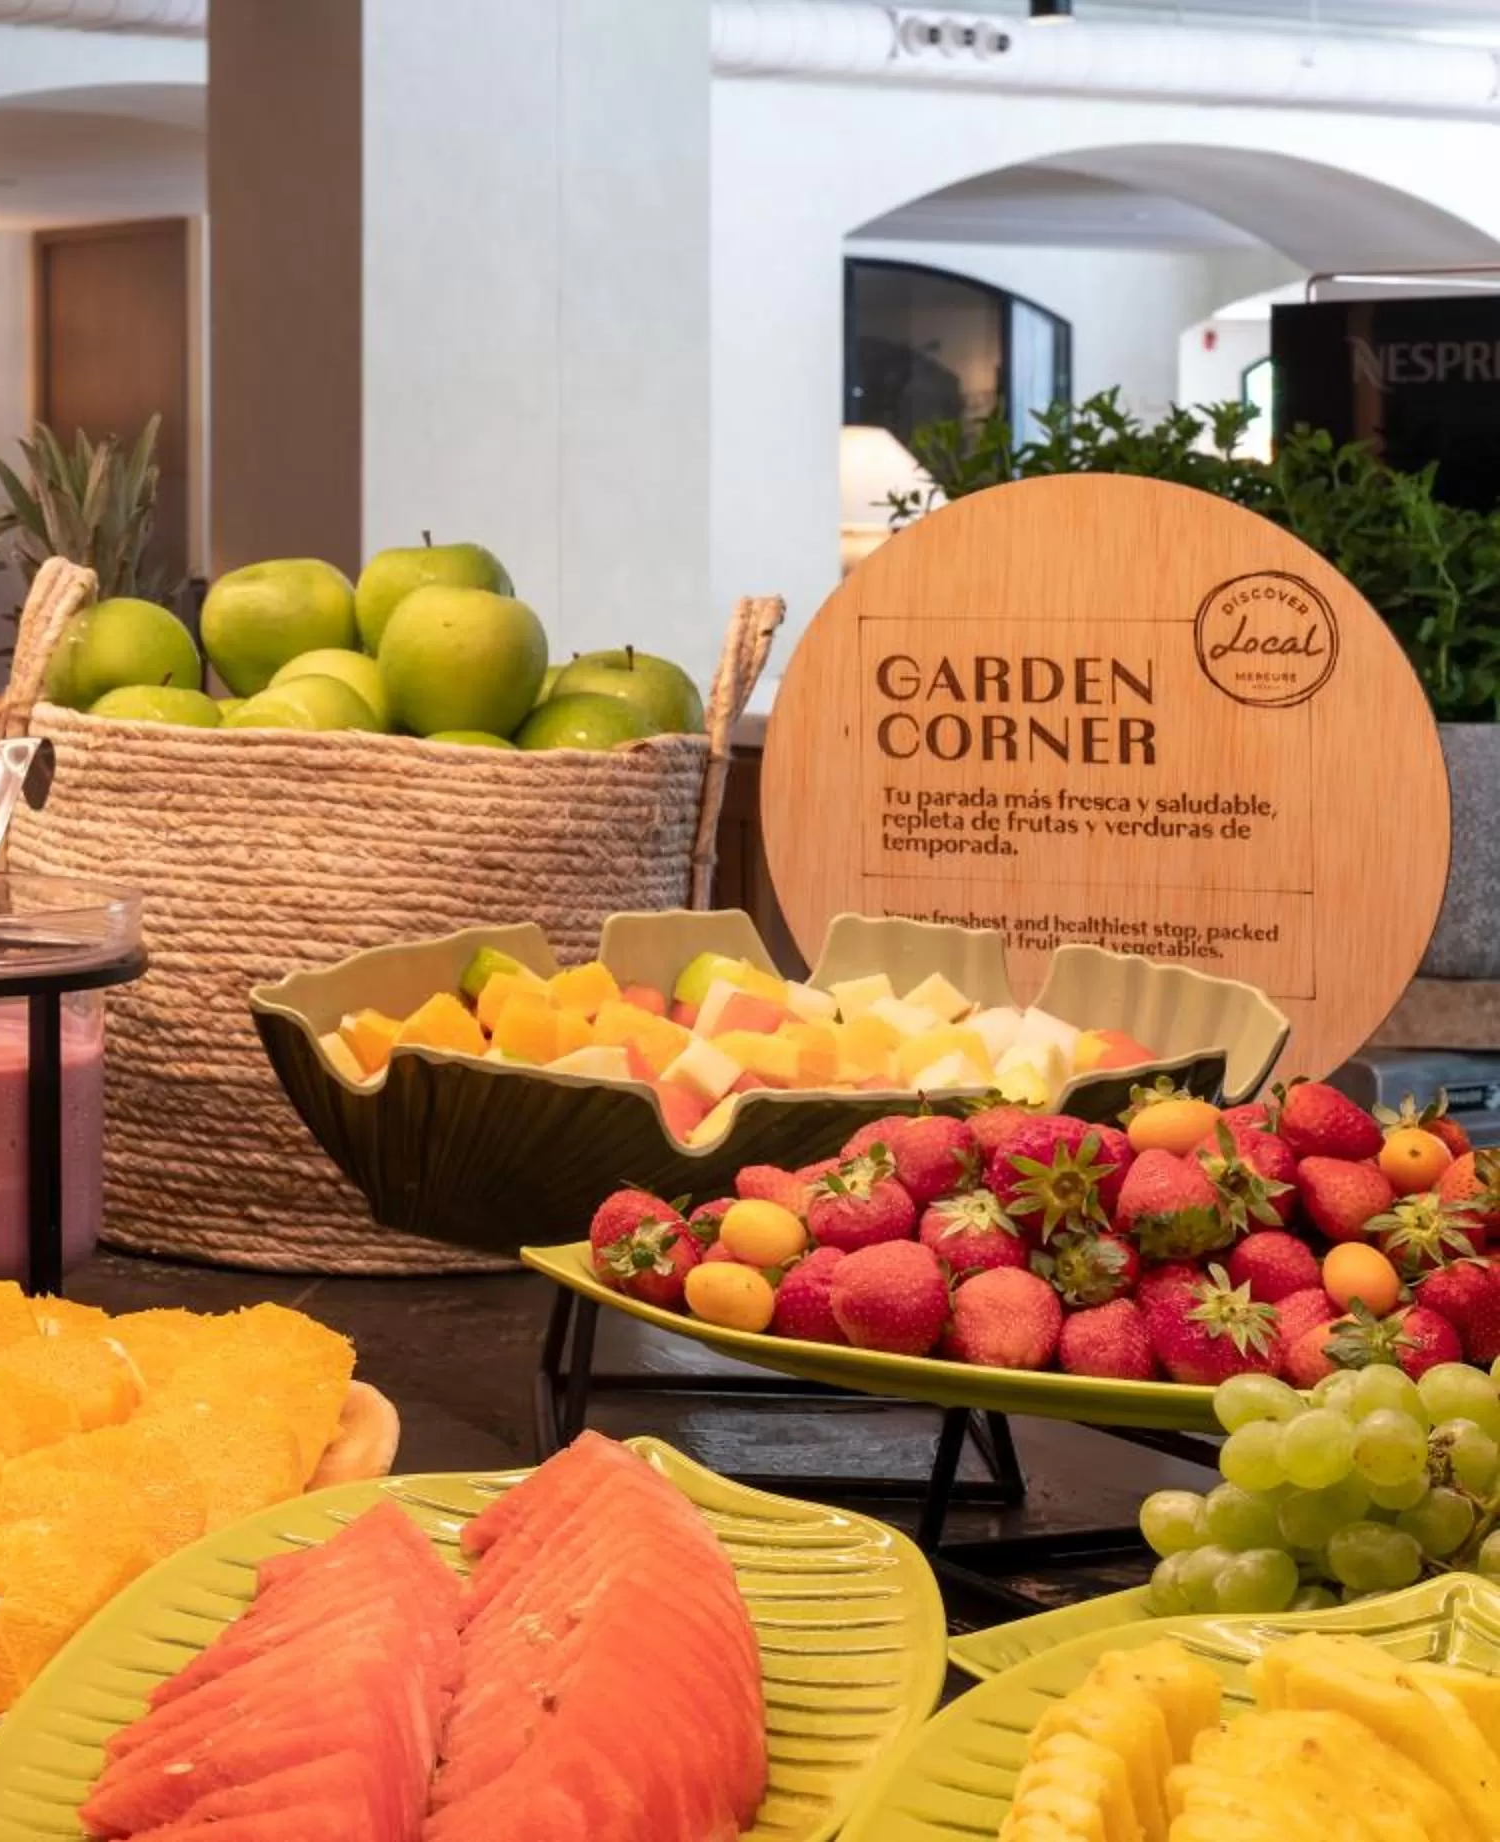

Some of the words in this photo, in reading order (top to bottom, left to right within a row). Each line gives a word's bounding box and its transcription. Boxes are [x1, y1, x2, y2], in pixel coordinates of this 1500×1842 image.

[1221, 587, 1309, 615] DISCOVER
[1210, 614, 1323, 660] Local
[876, 654, 1153, 705] GARDEN
[1235, 671, 1297, 683] MERCURE
[877, 712, 1156, 765] CORNER
[883, 787, 911, 806] Tu
[917, 786, 999, 812] parada
[1004, 788, 1052, 809] más
[1058, 789, 1131, 812] fresca
[1137, 797, 1150, 816] y
[1155, 791, 1277, 821] saludable,
[882, 808, 965, 836] repleta
[971, 809, 1000, 831] de
[1007, 811, 1079, 834] frutas
[1085, 819, 1097, 838] y
[1105, 816, 1214, 839] verduras
[1220, 817, 1252, 840] de
[882, 832, 1019, 860] temporada.
[933, 909, 1008, 930] freshest
[1014, 914, 1049, 932] and
[1054, 915, 1148, 937] healthiest
[1153, 922, 1202, 943] stop,
[1207, 923, 1280, 943] packed
[1017, 932, 1061, 950] fruit
[1112, 940, 1225, 959] vegetables.
